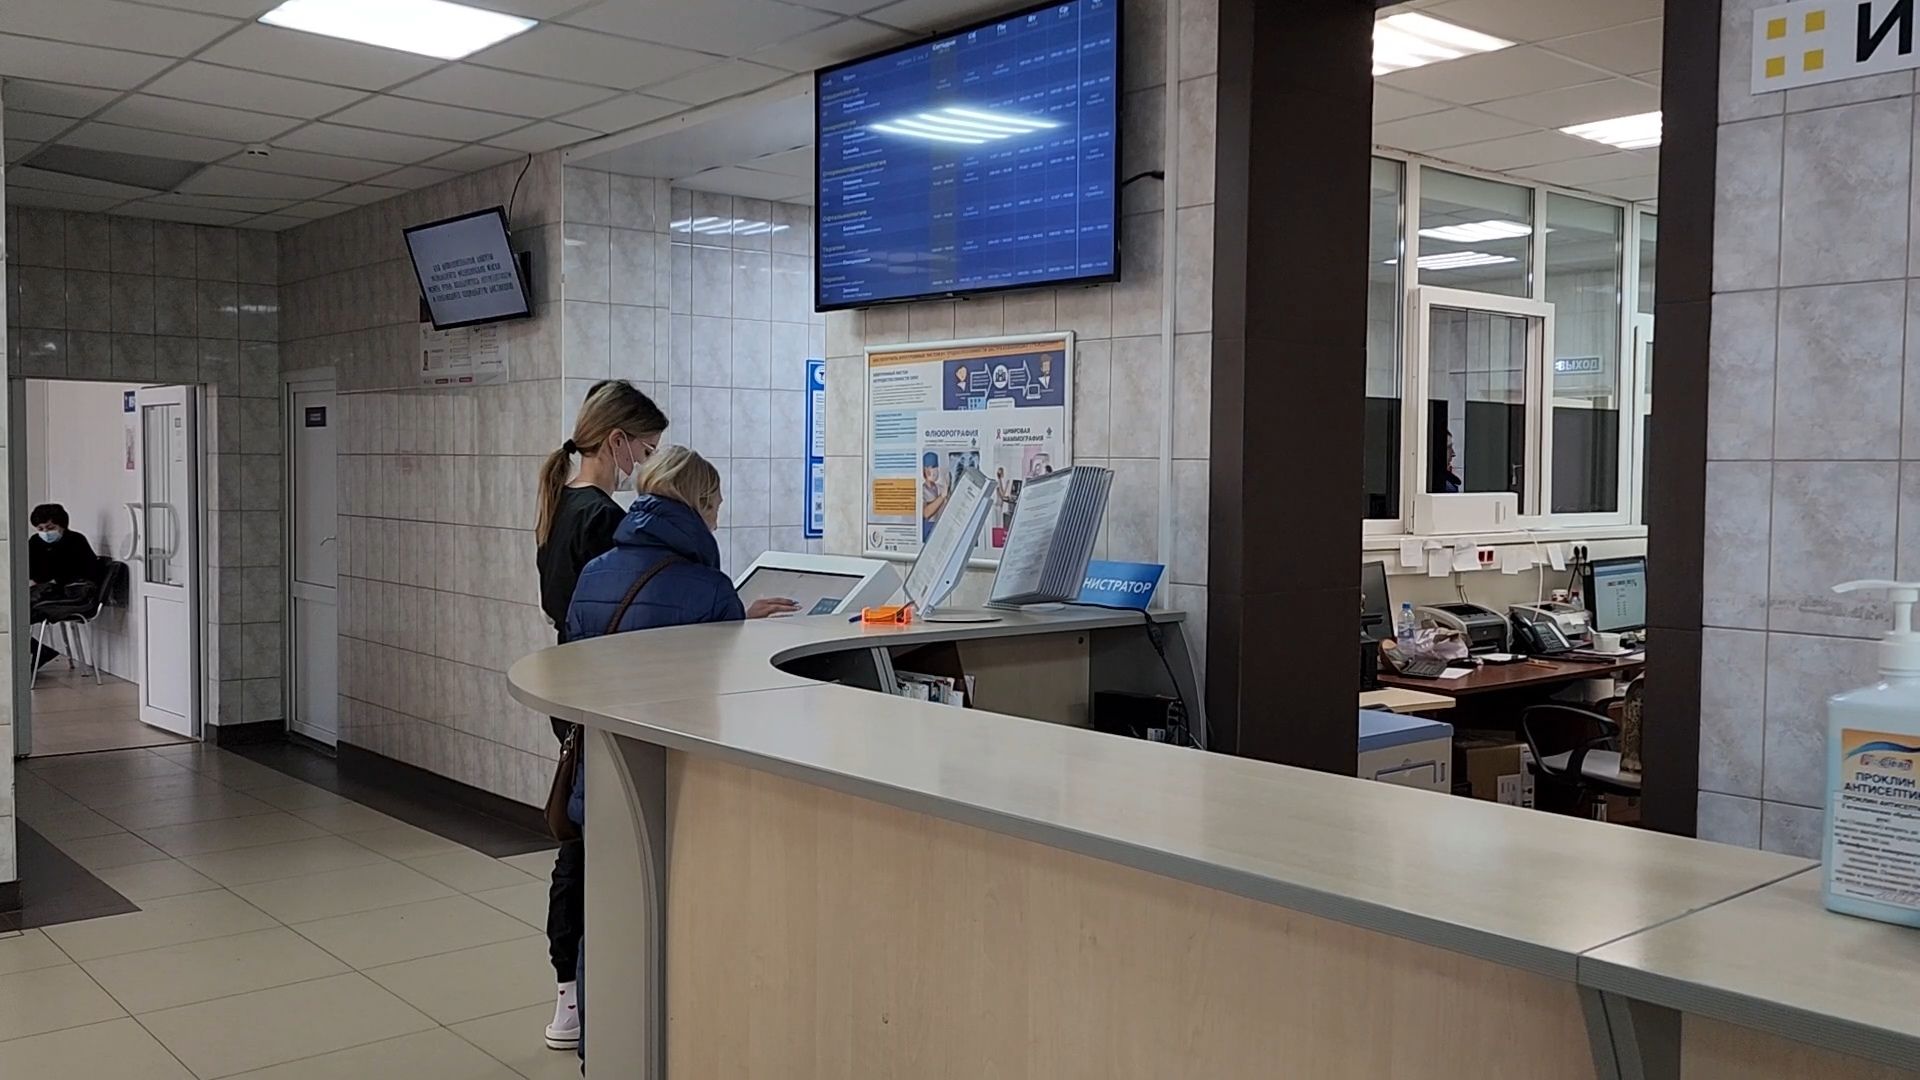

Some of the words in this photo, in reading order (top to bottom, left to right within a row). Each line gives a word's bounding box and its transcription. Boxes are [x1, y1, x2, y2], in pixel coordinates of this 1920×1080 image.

[1856, 0, 1914, 62] И
[1558, 360, 1599, 371] ВЫХОД
[1855, 772, 1916, 788] ПРОКЛИН
